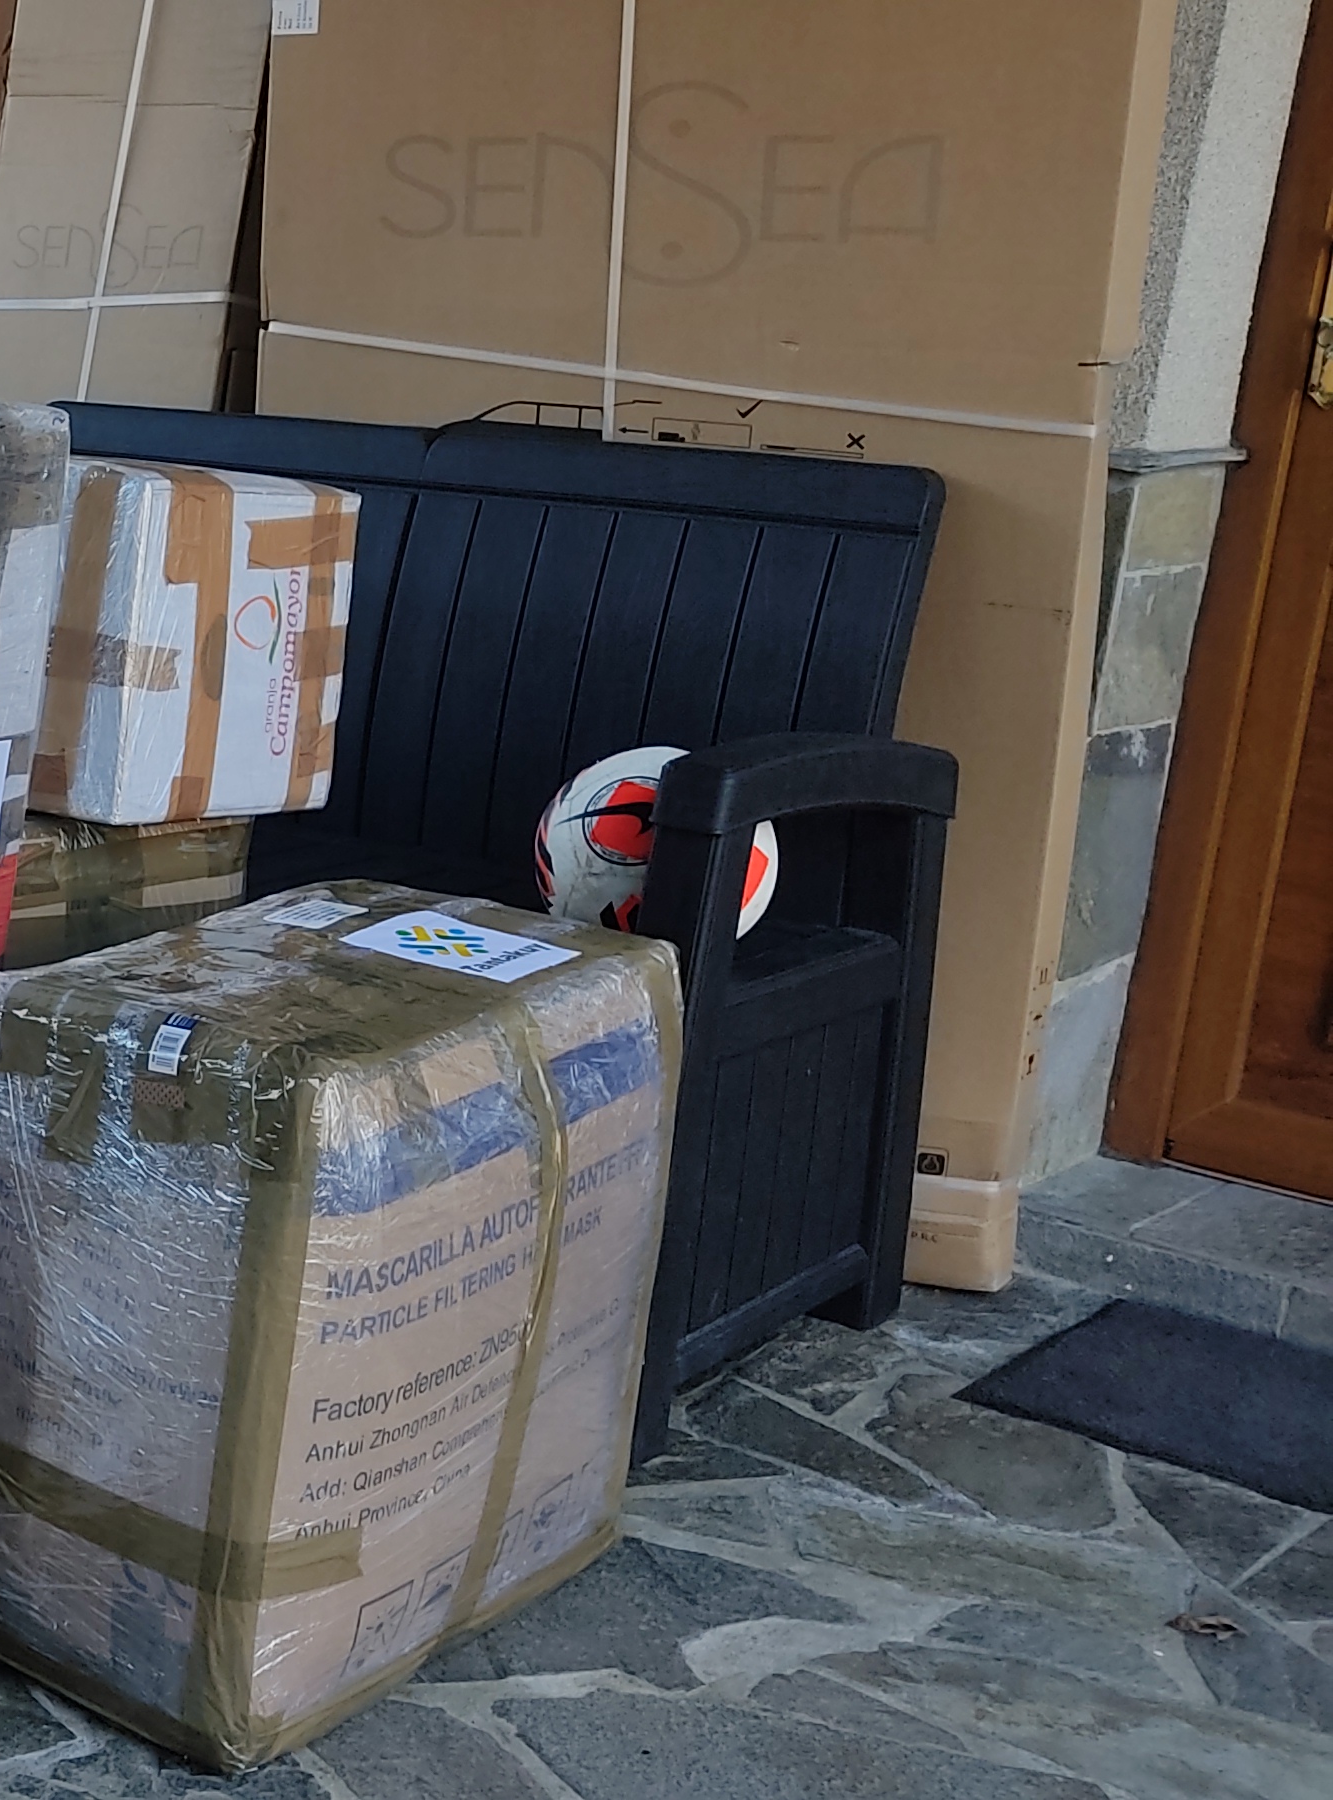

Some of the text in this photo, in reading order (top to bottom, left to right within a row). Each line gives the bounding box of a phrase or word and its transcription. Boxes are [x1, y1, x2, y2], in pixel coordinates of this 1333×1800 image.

[458, 942, 552, 974] Tantakuy
[319, 1294, 429, 1345] PARTICLE
[433, 1252, 517, 1313] FILTERING
[561, 1204, 603, 1248] MASK
[325, 1227, 476, 1301] MASCARILLA
[311, 1389, 396, 1425] Factory
[395, 1351, 479, 1401] reference:
[304, 1435, 365, 1463] Anhui
[369, 1405, 446, 1450] Zhongnan
[449, 1394, 469, 1416] Air
[298, 1478, 348, 1504] Add:
[353, 1451, 427, 1491] Qianshan
